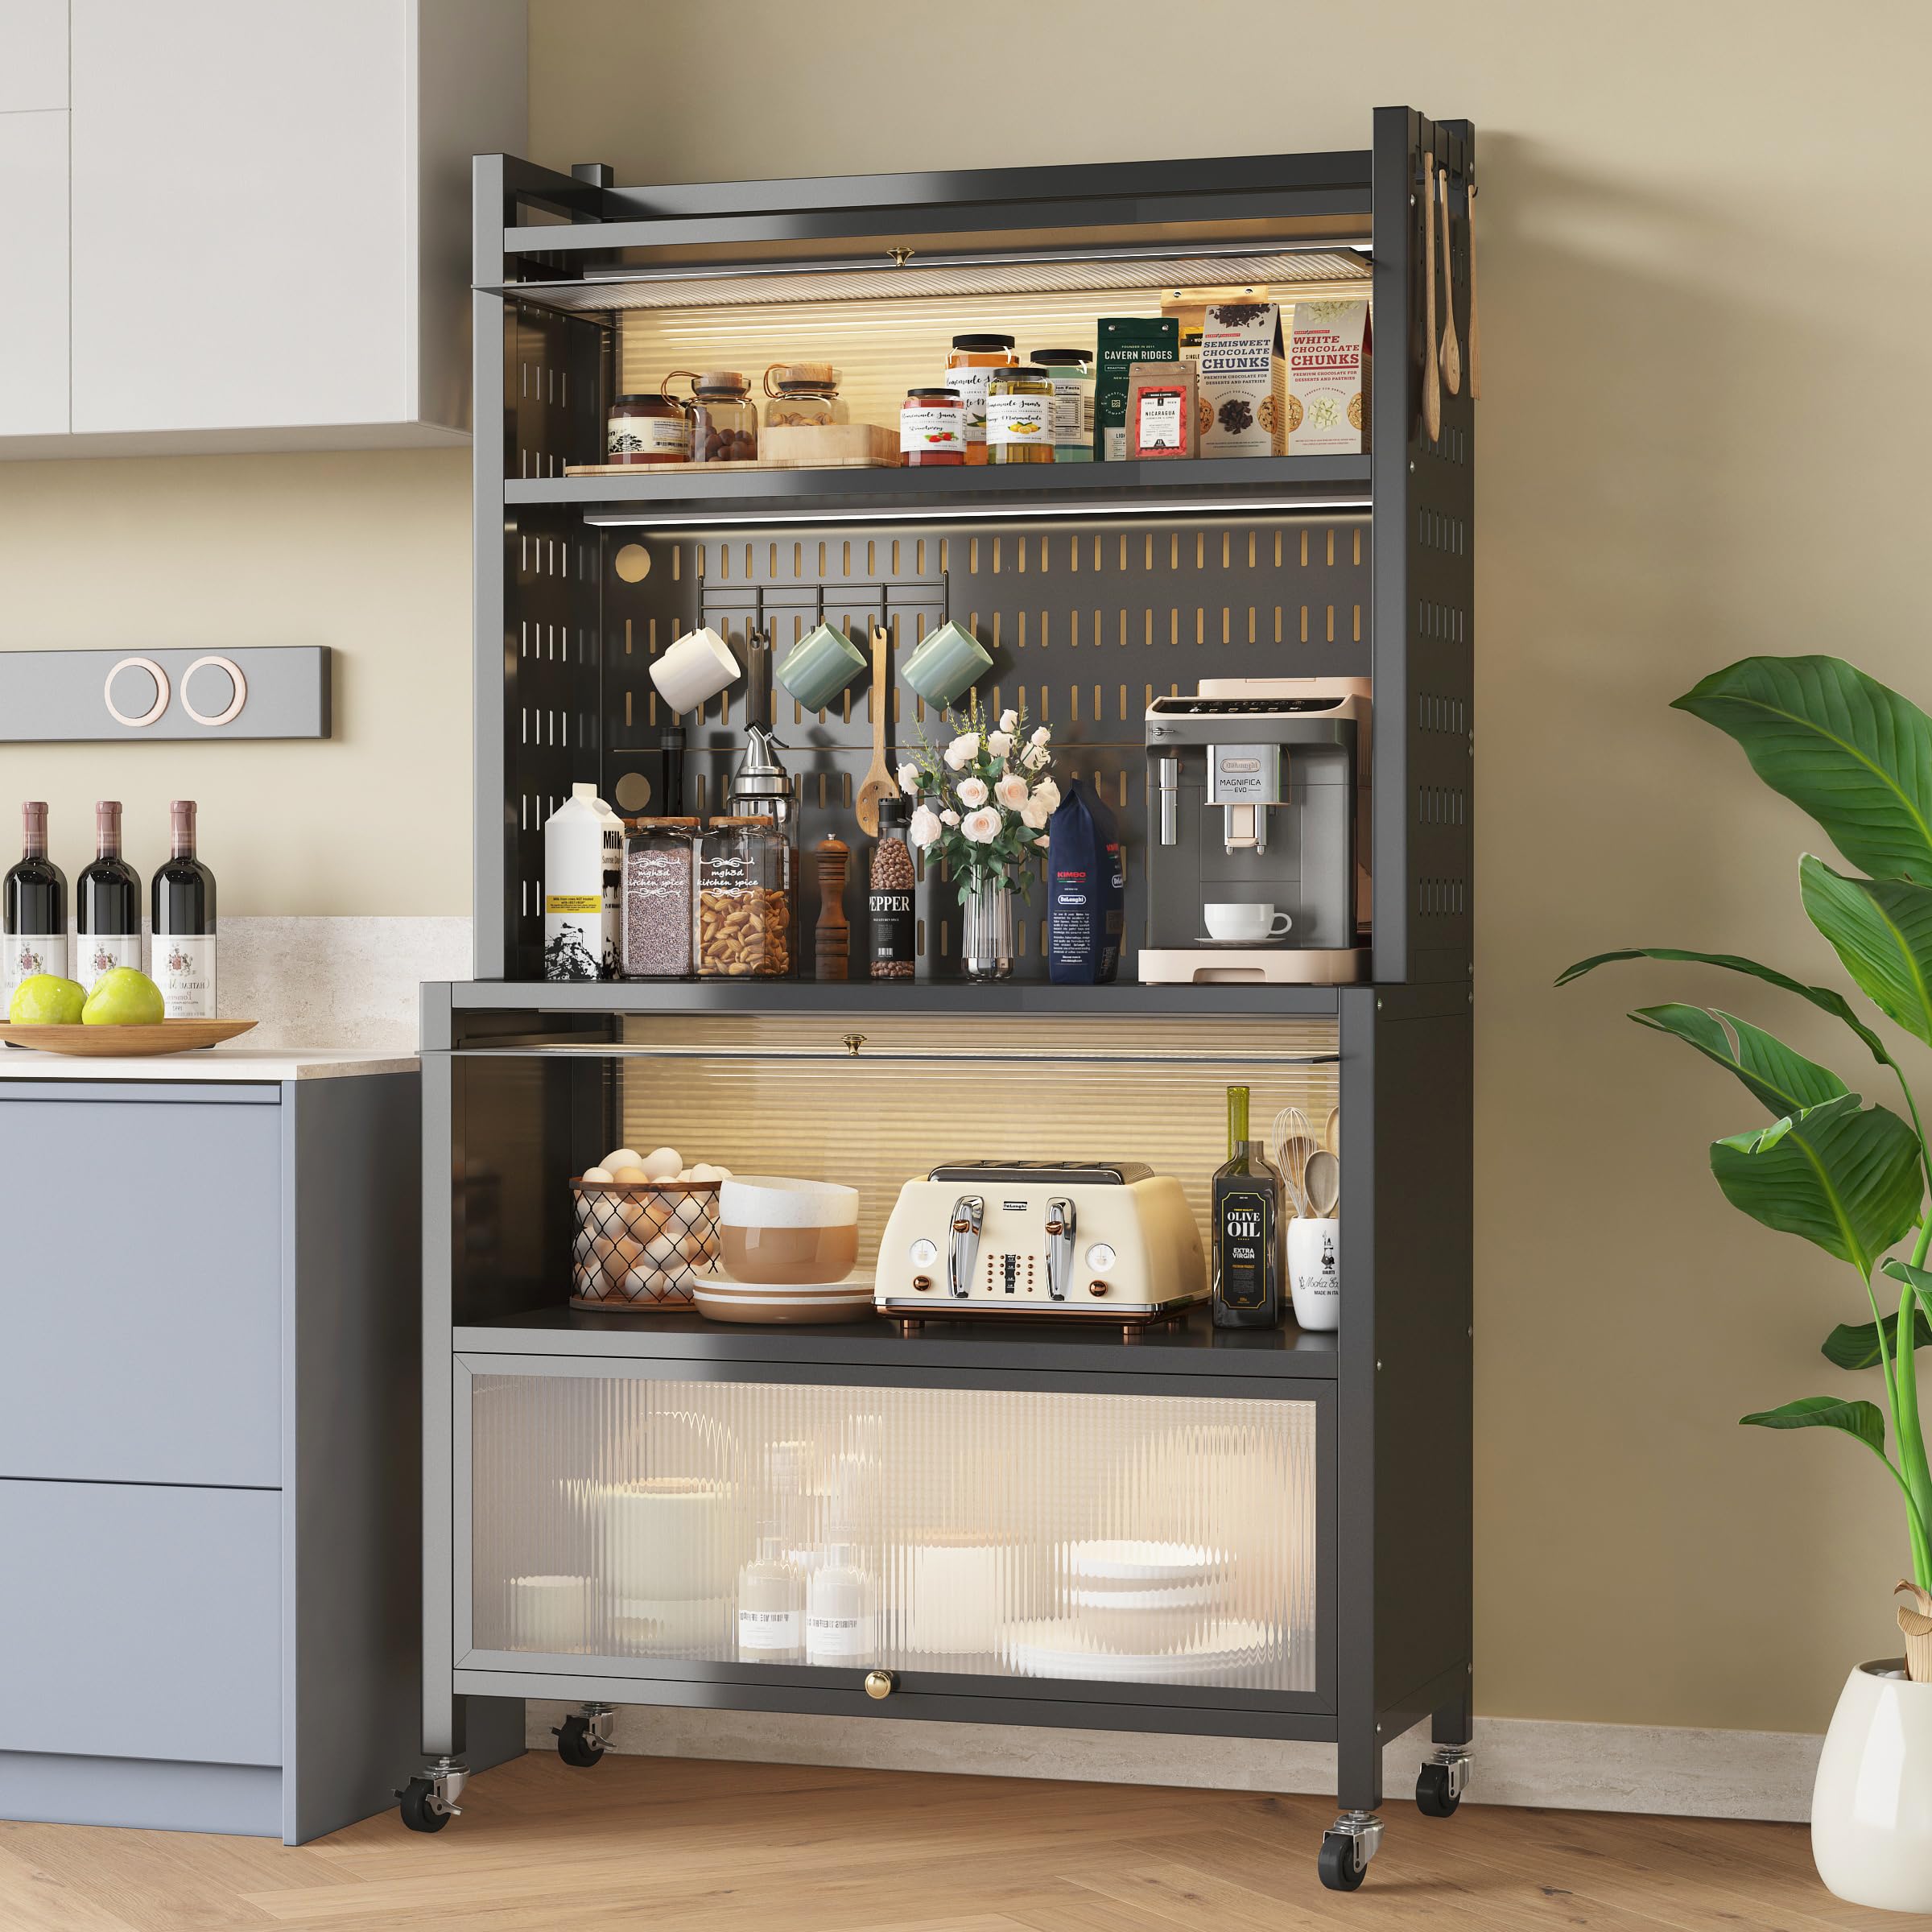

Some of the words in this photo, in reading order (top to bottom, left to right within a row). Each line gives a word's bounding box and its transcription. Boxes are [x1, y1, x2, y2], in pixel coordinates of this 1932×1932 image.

[1203, 340, 1271, 348] SEMISWEET
[1293, 336, 1340, 345] WHITE
[1203, 348, 1269, 357] CHOCOLATE
[1292, 345, 1360, 353] CHOCOLATE
[1104, 351, 1138, 360] CAVERN
[1141, 351, 1173, 360] RIDGES
[1291, 354, 1359, 366] CHUNKS
[1203, 357, 1269, 369] CHUNKS
[735, 879, 759, 887] spice
[1227, 1212, 1261, 1222] OLIVE
[1228, 1222, 1261, 1237] OIL
